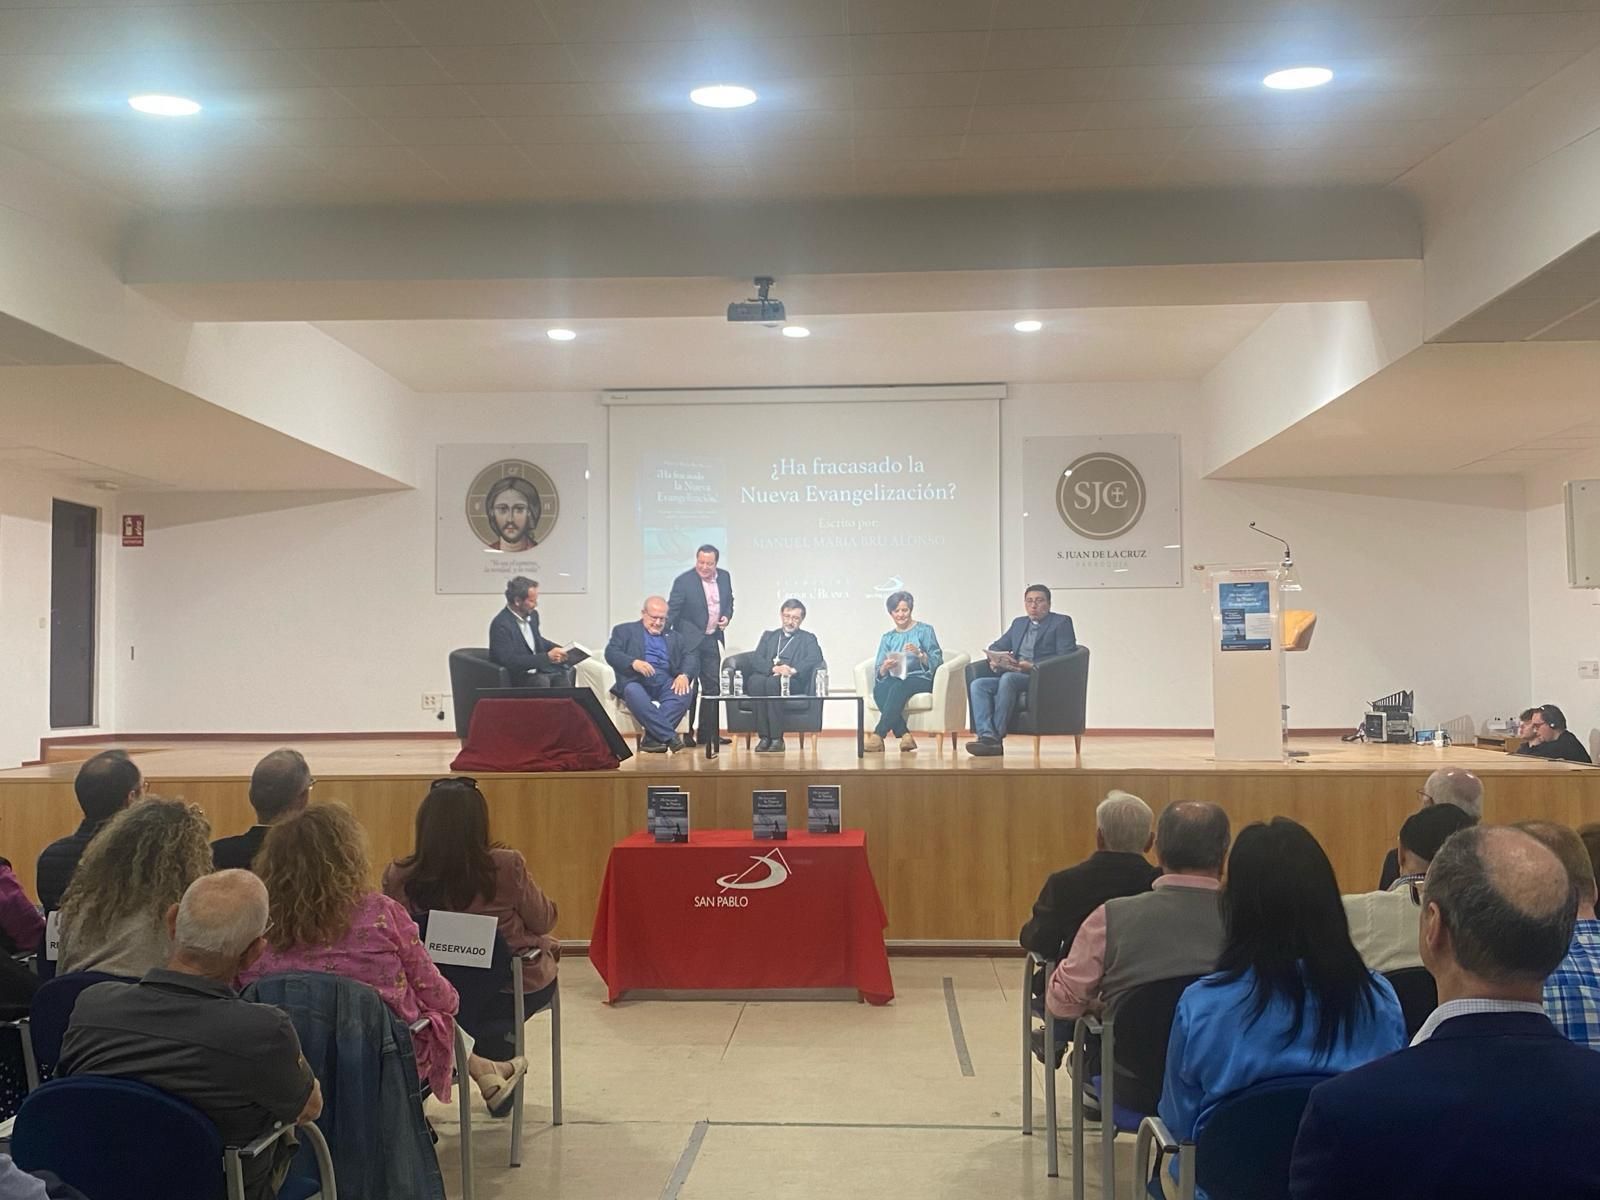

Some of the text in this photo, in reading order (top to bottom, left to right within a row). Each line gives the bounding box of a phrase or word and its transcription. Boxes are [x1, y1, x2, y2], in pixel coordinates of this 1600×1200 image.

[770, 455, 924, 480] ¿Ha fracasado la
[740, 483, 956, 507] Nueva Evangelización?
[1073, 480, 1129, 515] SJC
[818, 518, 880, 531] Escrito por:
[753, 536, 809, 549] MANUEL
[1056, 549, 1147, 560] S. JUAN DE LA CRUZ
[694, 895, 749, 908] SAN PABLO
[428, 942, 486, 956] RESERVADO
